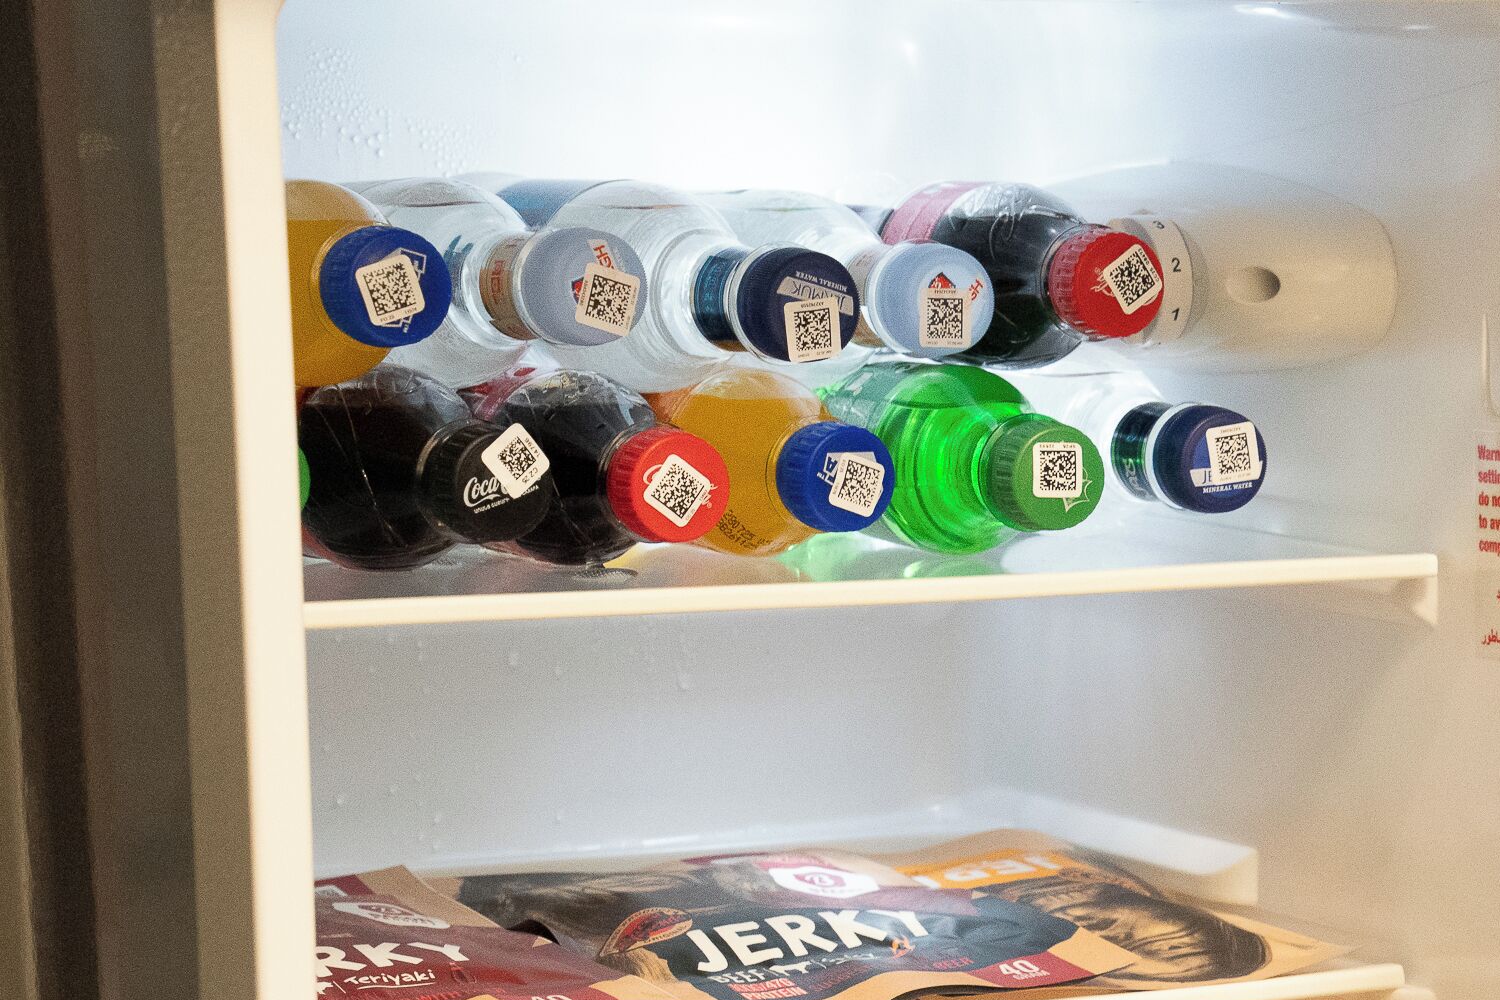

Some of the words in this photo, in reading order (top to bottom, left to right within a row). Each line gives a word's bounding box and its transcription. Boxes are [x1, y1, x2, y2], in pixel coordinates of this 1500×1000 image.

[1153, 220, 1165, 230] 3
[1171, 257, 1181, 273] 2
[795, 270, 819, 284] WATER
[819, 277, 848, 293] MINERAL
[1172, 307, 1180, 321] 1
[1202, 485, 1232, 494] MINERAL
[1233, 481, 1252, 490] WATER
[1478, 492, 1489, 507] do
[1479, 514, 1487, 529] to
[686, 908, 931, 972] JERKY
[707, 967, 767, 986] BEEF
[997, 959, 1037, 979] 40
[344, 969, 437, 987] Teriyaki
[738, 987, 808, 1000] PROTEIN
